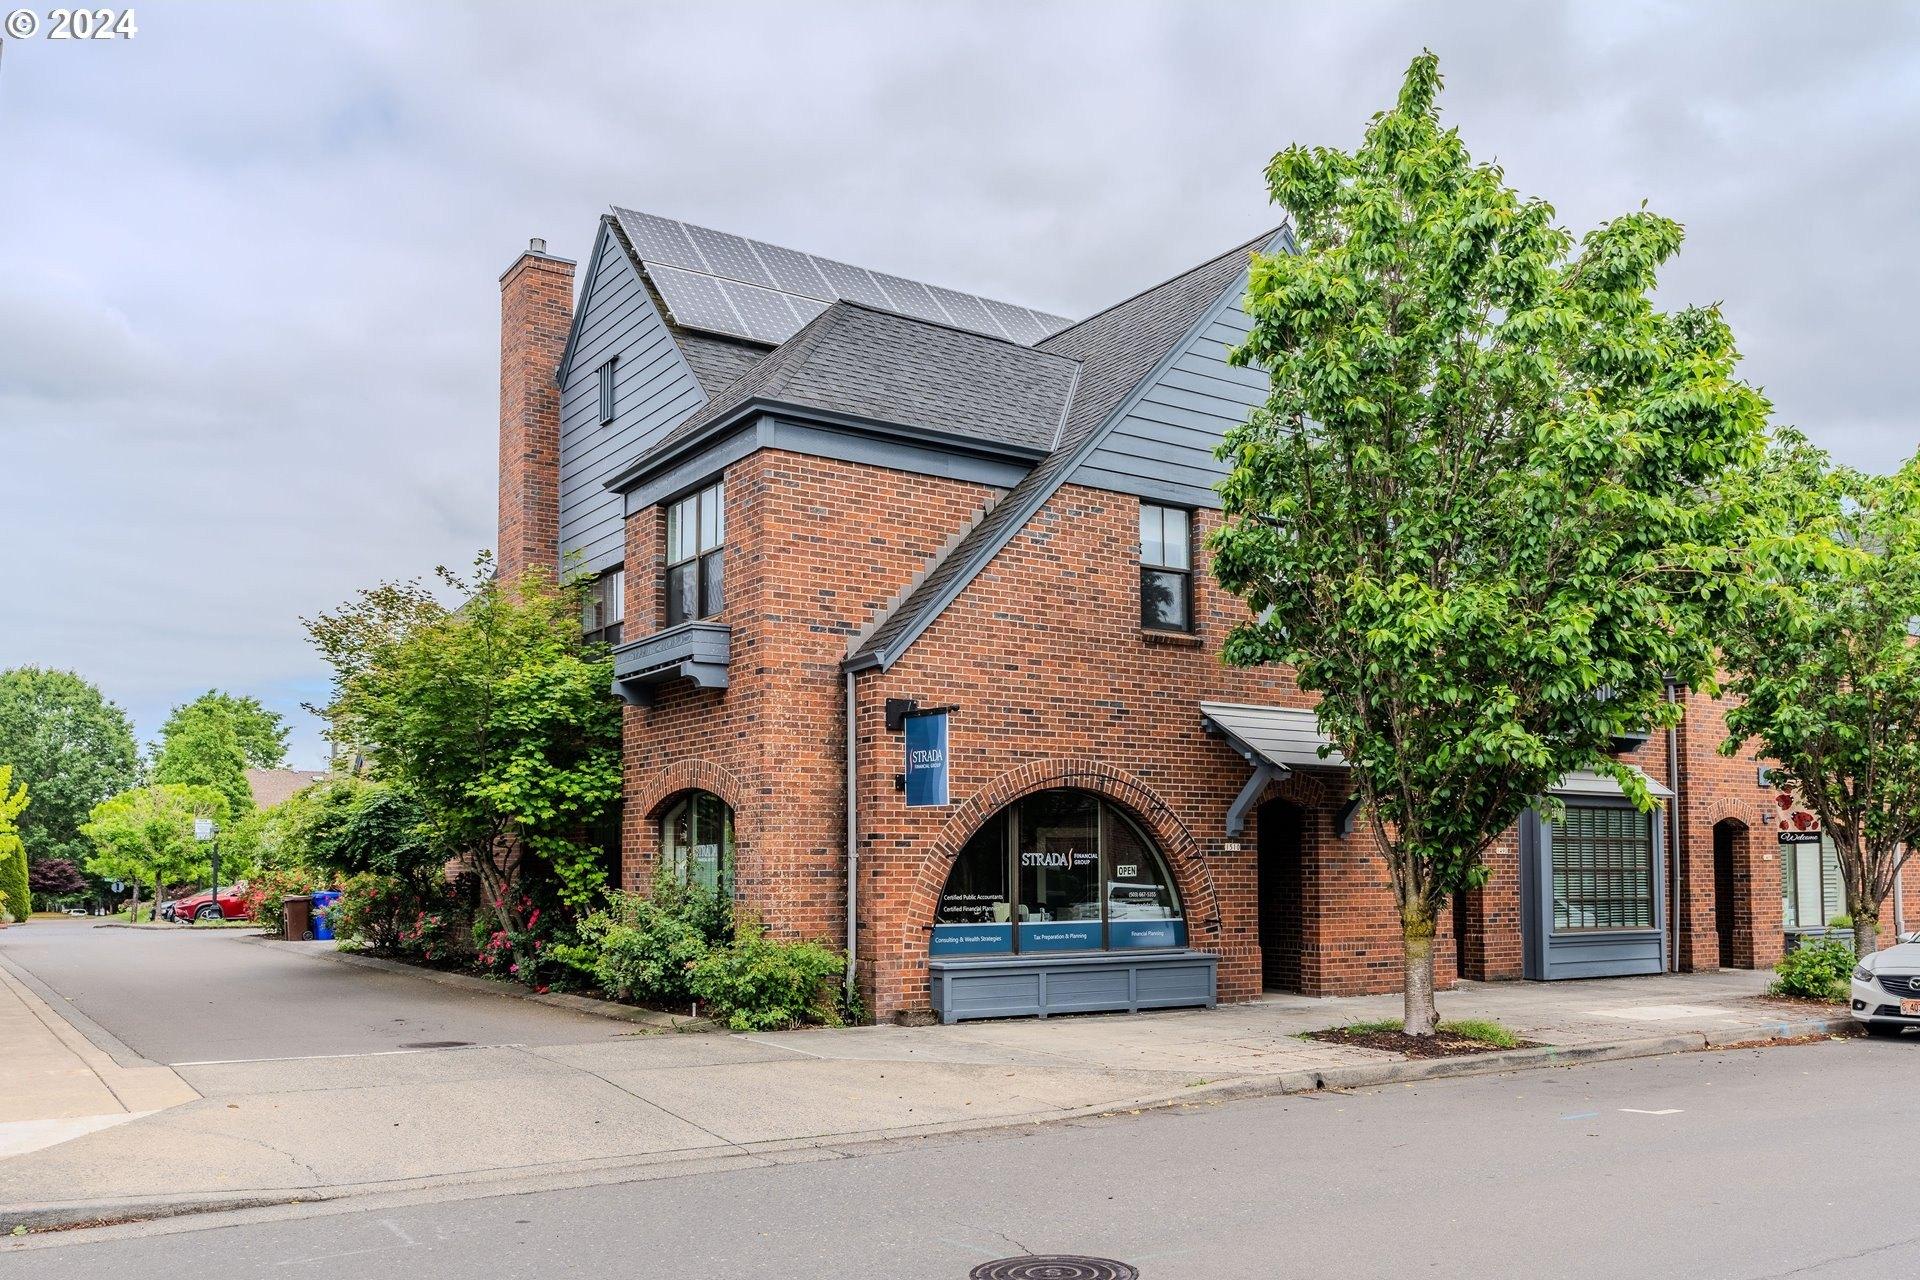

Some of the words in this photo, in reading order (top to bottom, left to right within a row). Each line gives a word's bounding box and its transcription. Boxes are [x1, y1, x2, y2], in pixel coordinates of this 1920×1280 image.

[913, 749, 943, 763] STRADA
[1780, 832, 1819, 842] Welcome
[1021, 852, 1069, 866] STRADA
[1118, 866, 1136, 875] OPEN
[1069, 932, 1087, 940] Planning
